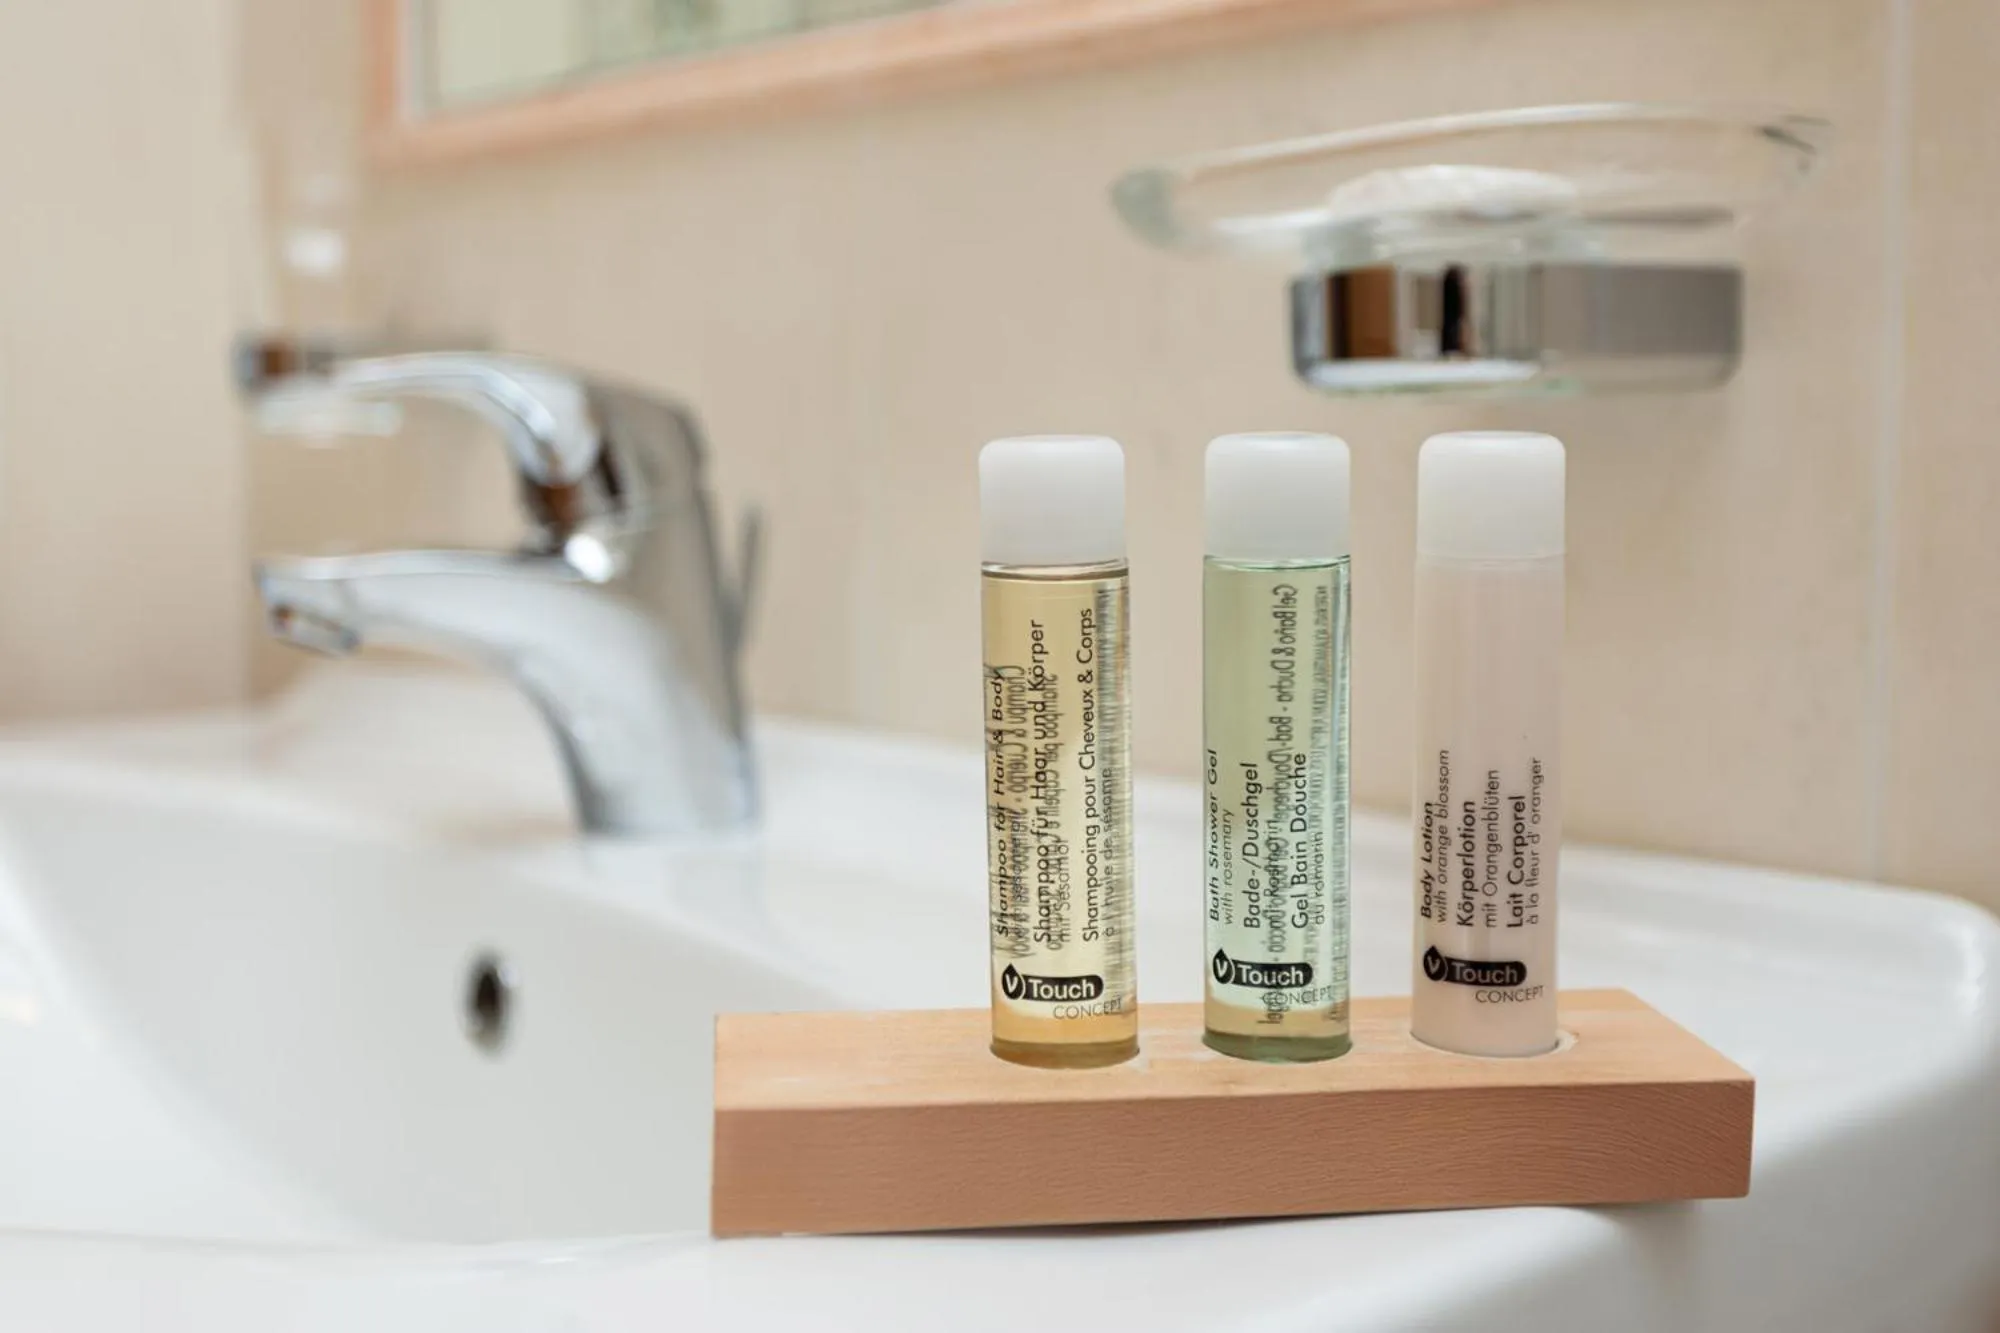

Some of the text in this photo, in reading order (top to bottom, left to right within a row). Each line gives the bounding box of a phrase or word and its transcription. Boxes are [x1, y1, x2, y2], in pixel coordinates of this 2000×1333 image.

[1027, 619, 1048, 692] Körper
[991, 670, 1005, 721] Body
[1028, 701, 1046, 739] und
[992, 746, 1005, 796] Hair
[1030, 748, 1047, 799] Haar
[1076, 608, 1100, 942] Shampooing pour Cheveux & Corps
[1531, 757, 1545, 825] oranger
[993, 803, 1006, 831] for
[1030, 807, 1048, 836] für
[1207, 749, 1219, 921] Bath Shower Gel
[1289, 753, 1309, 928] Gel Bain Douche
[1433, 749, 1451, 923] with orange blossom
[1220, 809, 1234, 925] with rosemary
[1240, 763, 1262, 928] Bade-/Duschgel
[1311, 831, 1325, 897] romarin
[1420, 802, 1435, 918] Body Lotion
[1456, 800, 1478, 927] Körperlotion
[1481, 769, 1503, 928] mit Orangenblüten
[1506, 795, 1528, 927] Lait Corporel
[1525, 850, 1540, 887] fleur
[995, 839, 1011, 937] Shampoo
[1032, 845, 1055, 942] Shampoo
[1525, 893, 1539, 908] la
[1314, 904, 1325, 925] au
[1525, 914, 1539, 925] à
[1028, 978, 1095, 999] Touch
[1237, 964, 1304, 985] Touch
[1261, 985, 1333, 1006] CONCEPT
[1450, 961, 1518, 984] Touch
[1474, 985, 1544, 1003] CONCEPT
[1053, 997, 1122, 1019] CONCEPT
